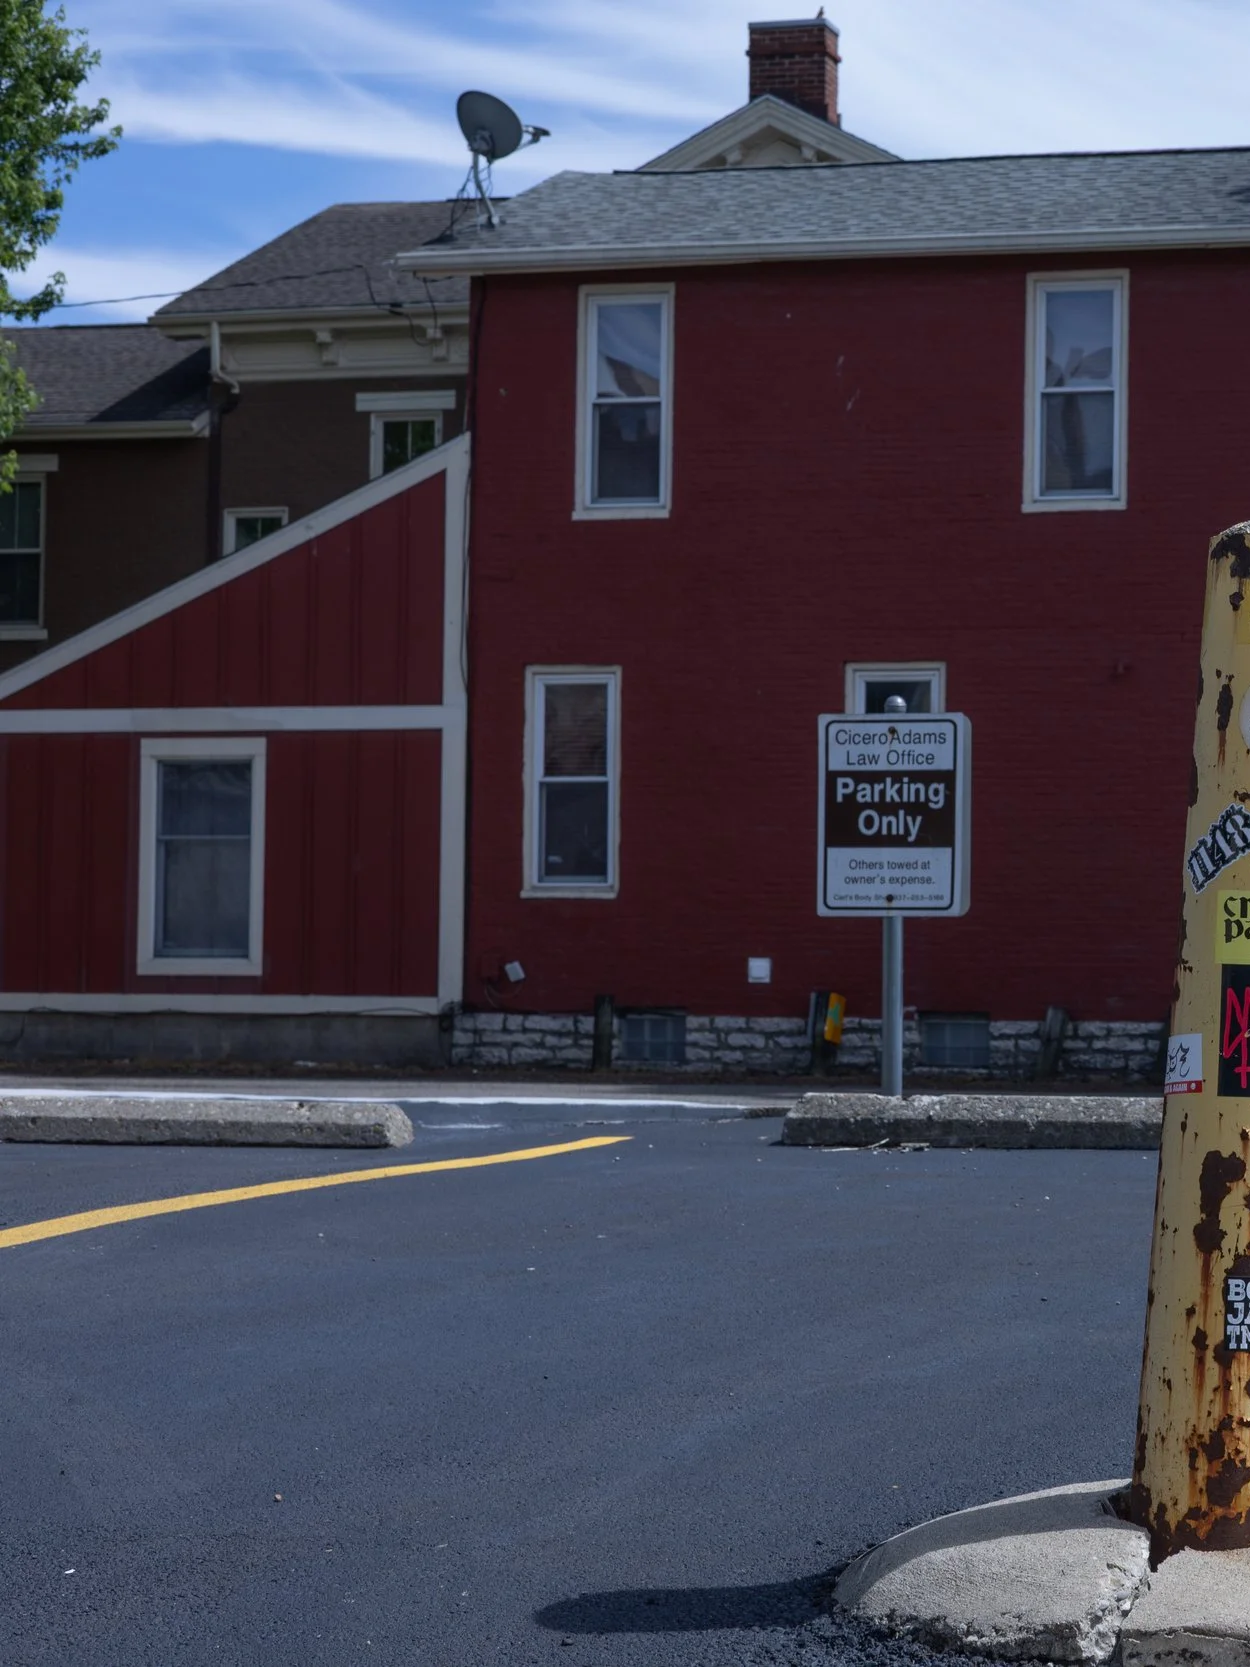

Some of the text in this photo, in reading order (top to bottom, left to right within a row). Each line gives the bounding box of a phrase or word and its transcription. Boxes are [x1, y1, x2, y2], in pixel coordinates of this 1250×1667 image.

[835, 729, 947, 745] Cicero Adams
[846, 750, 935, 766] Law Office
[836, 777, 946, 809] Parking
[857, 809, 922, 842] Only
[848, 859, 931, 870] Others towed at
[844, 874, 935, 887] owner's expense.
